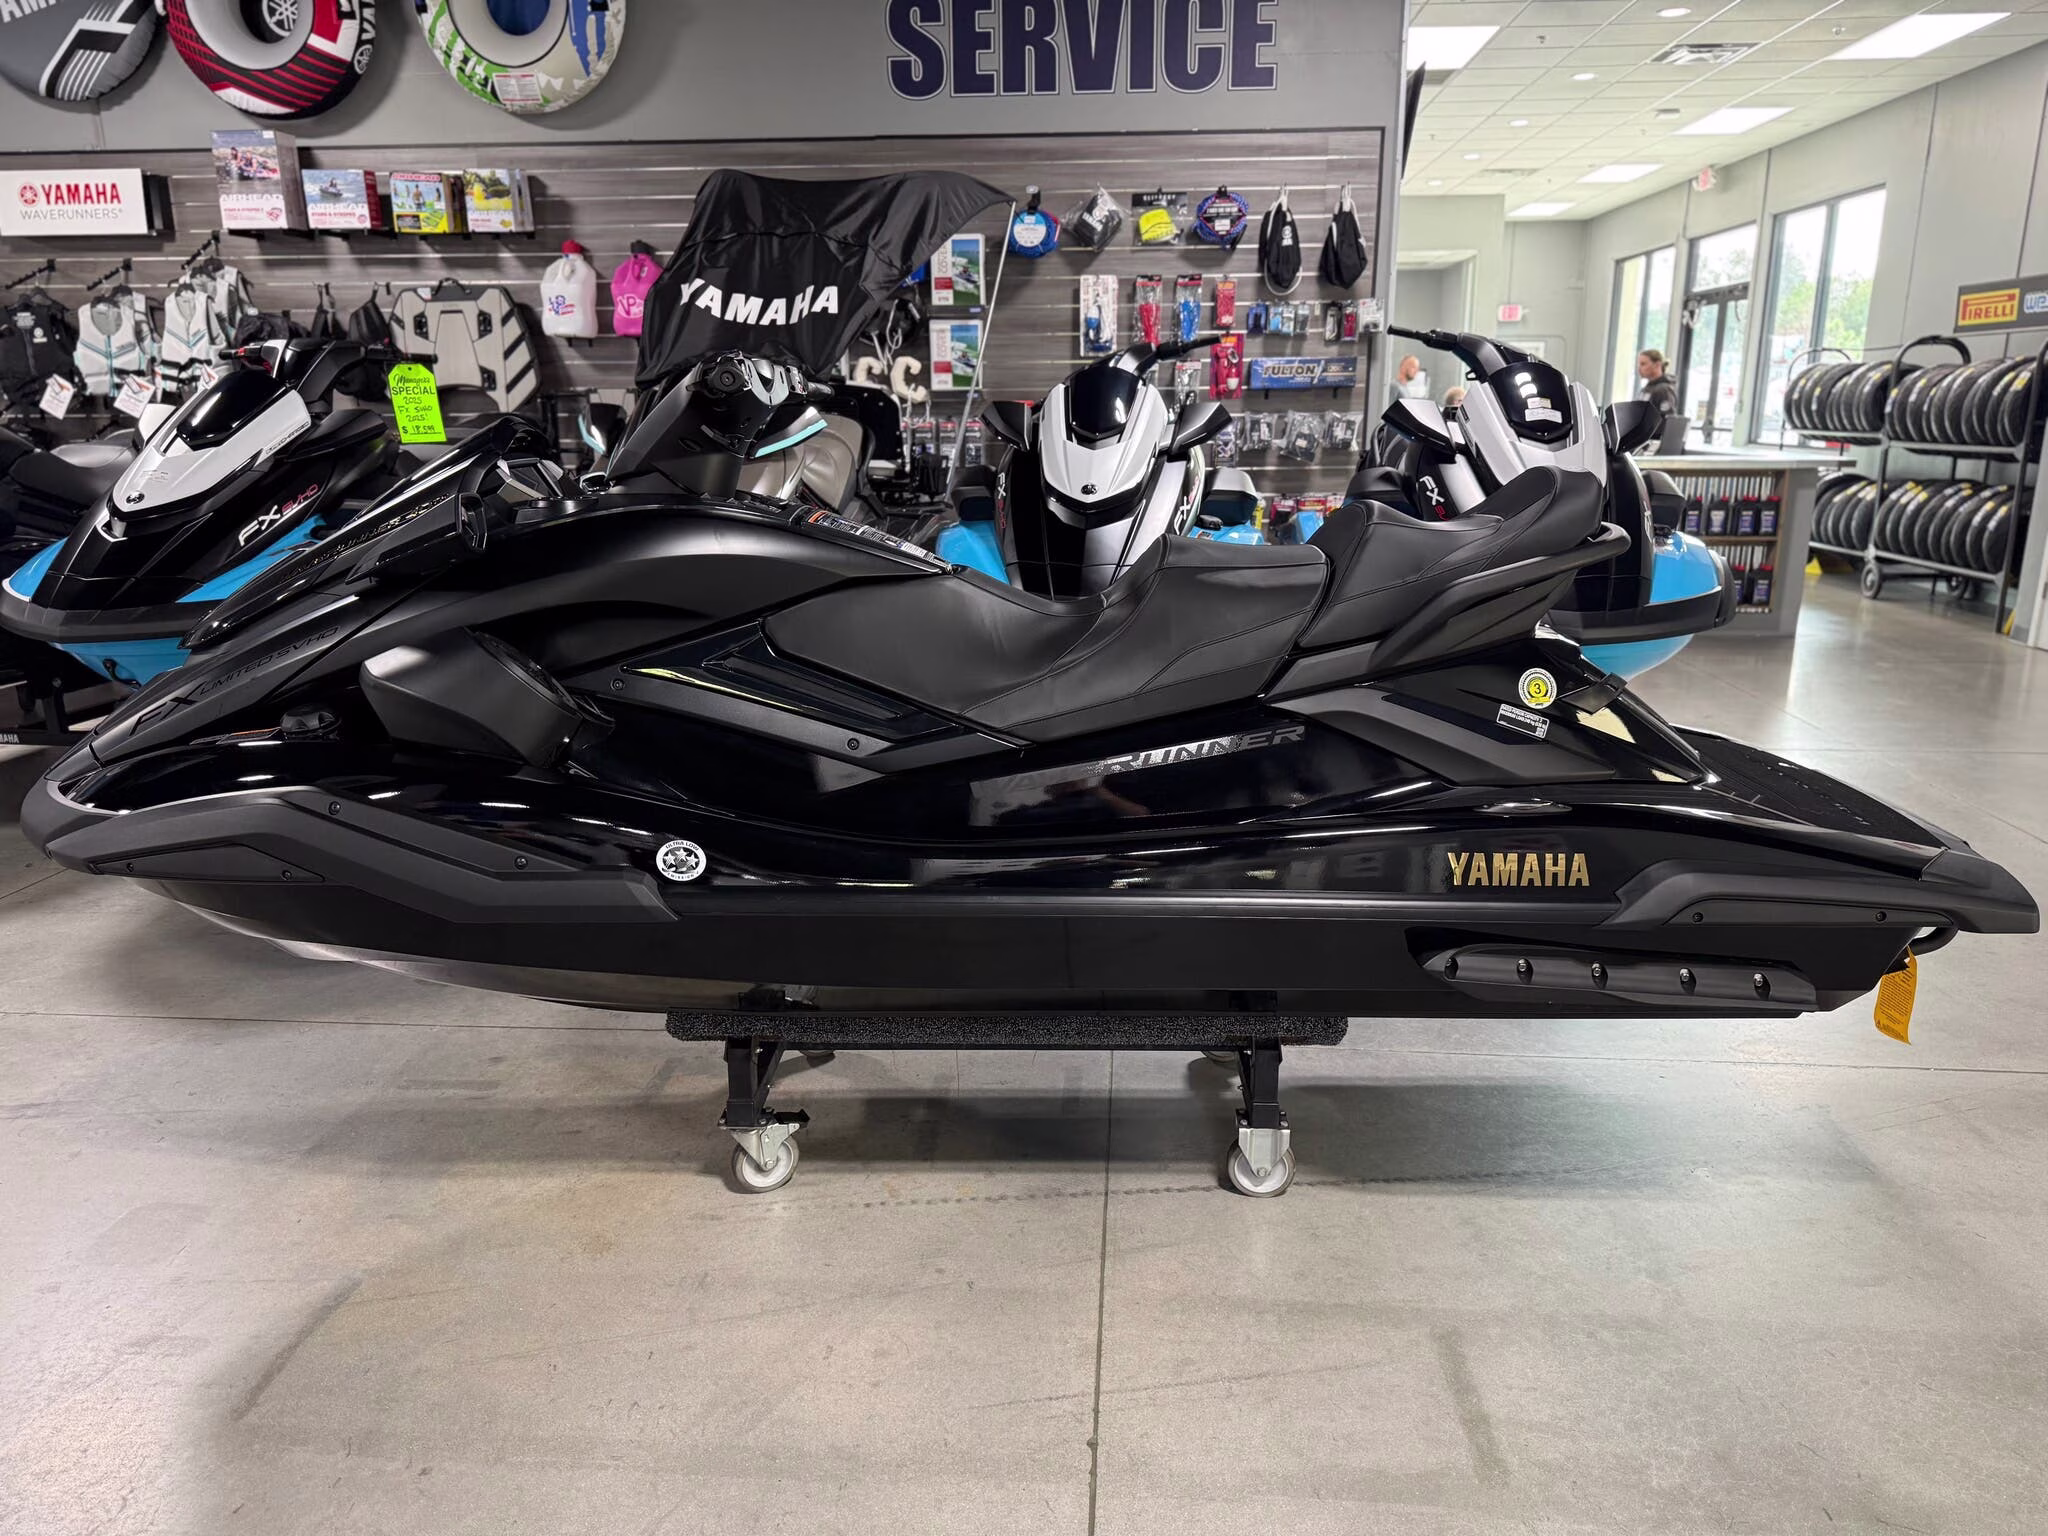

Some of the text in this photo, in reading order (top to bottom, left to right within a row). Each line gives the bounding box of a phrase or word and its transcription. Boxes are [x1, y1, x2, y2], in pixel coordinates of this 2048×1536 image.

[887, 0, 1279, 100] SERVICE
[41, 183, 121, 205] YAMAHA
[680, 278, 839, 326] YAMAHA
[1961, 293, 2017, 322] PIRELLI
[1263, 364, 1317, 378] FULTON
[391, 386, 436, 396] SPECIAL
[401, 426, 409, 434] $
[1420, 475, 1445, 506] FX
[239, 484, 319, 546] FX SVHO
[129, 626, 340, 736] FX LIMITED SVHO
[1533, 682, 1542, 695] 3
[1447, 852, 1590, 887] YAMAHA
